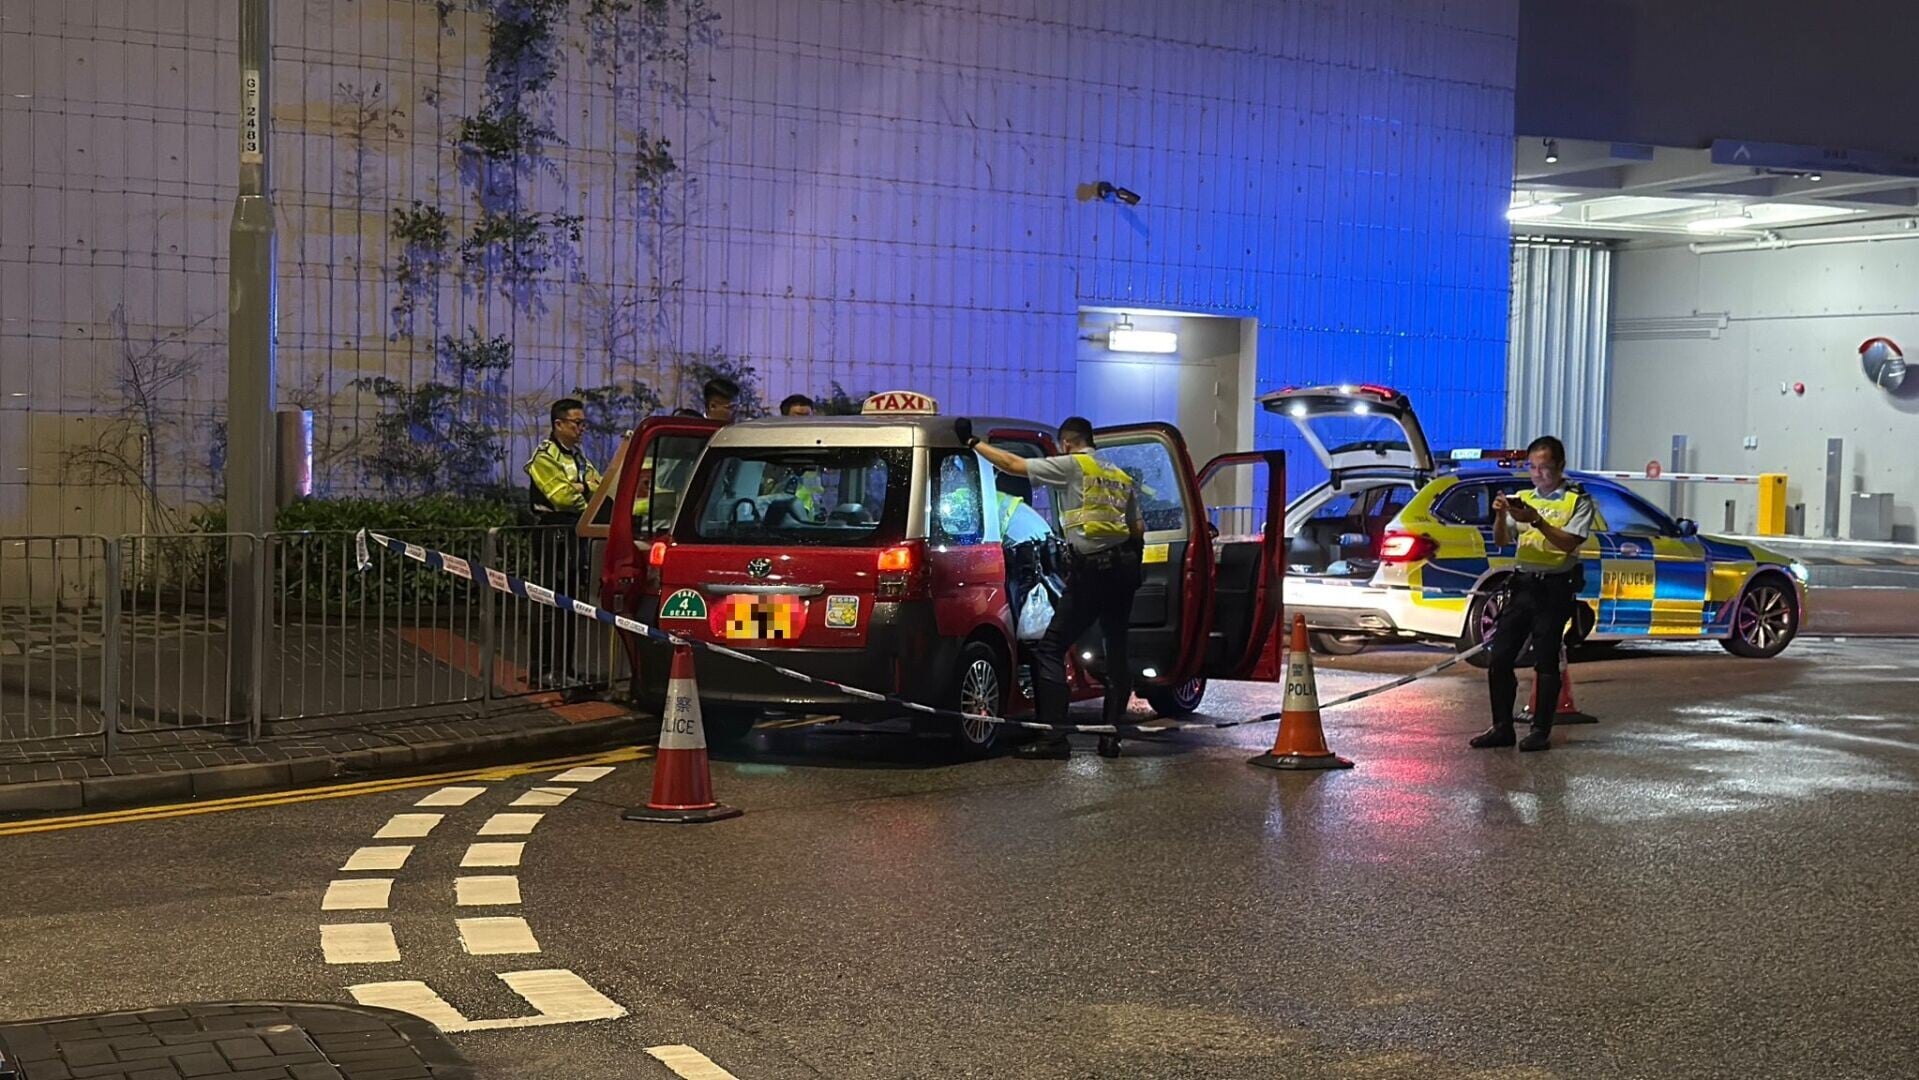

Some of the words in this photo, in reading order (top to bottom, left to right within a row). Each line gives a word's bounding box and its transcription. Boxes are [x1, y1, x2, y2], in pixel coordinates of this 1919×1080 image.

[246, 79, 256, 98] GF
[247, 107, 257, 152] 2483
[871, 393, 924, 410] TAXI
[1611, 571, 1645, 586] POLICE
[677, 591, 696, 599] TAXI
[679, 598, 689, 610] 4
[663, 718, 694, 735] LICE
